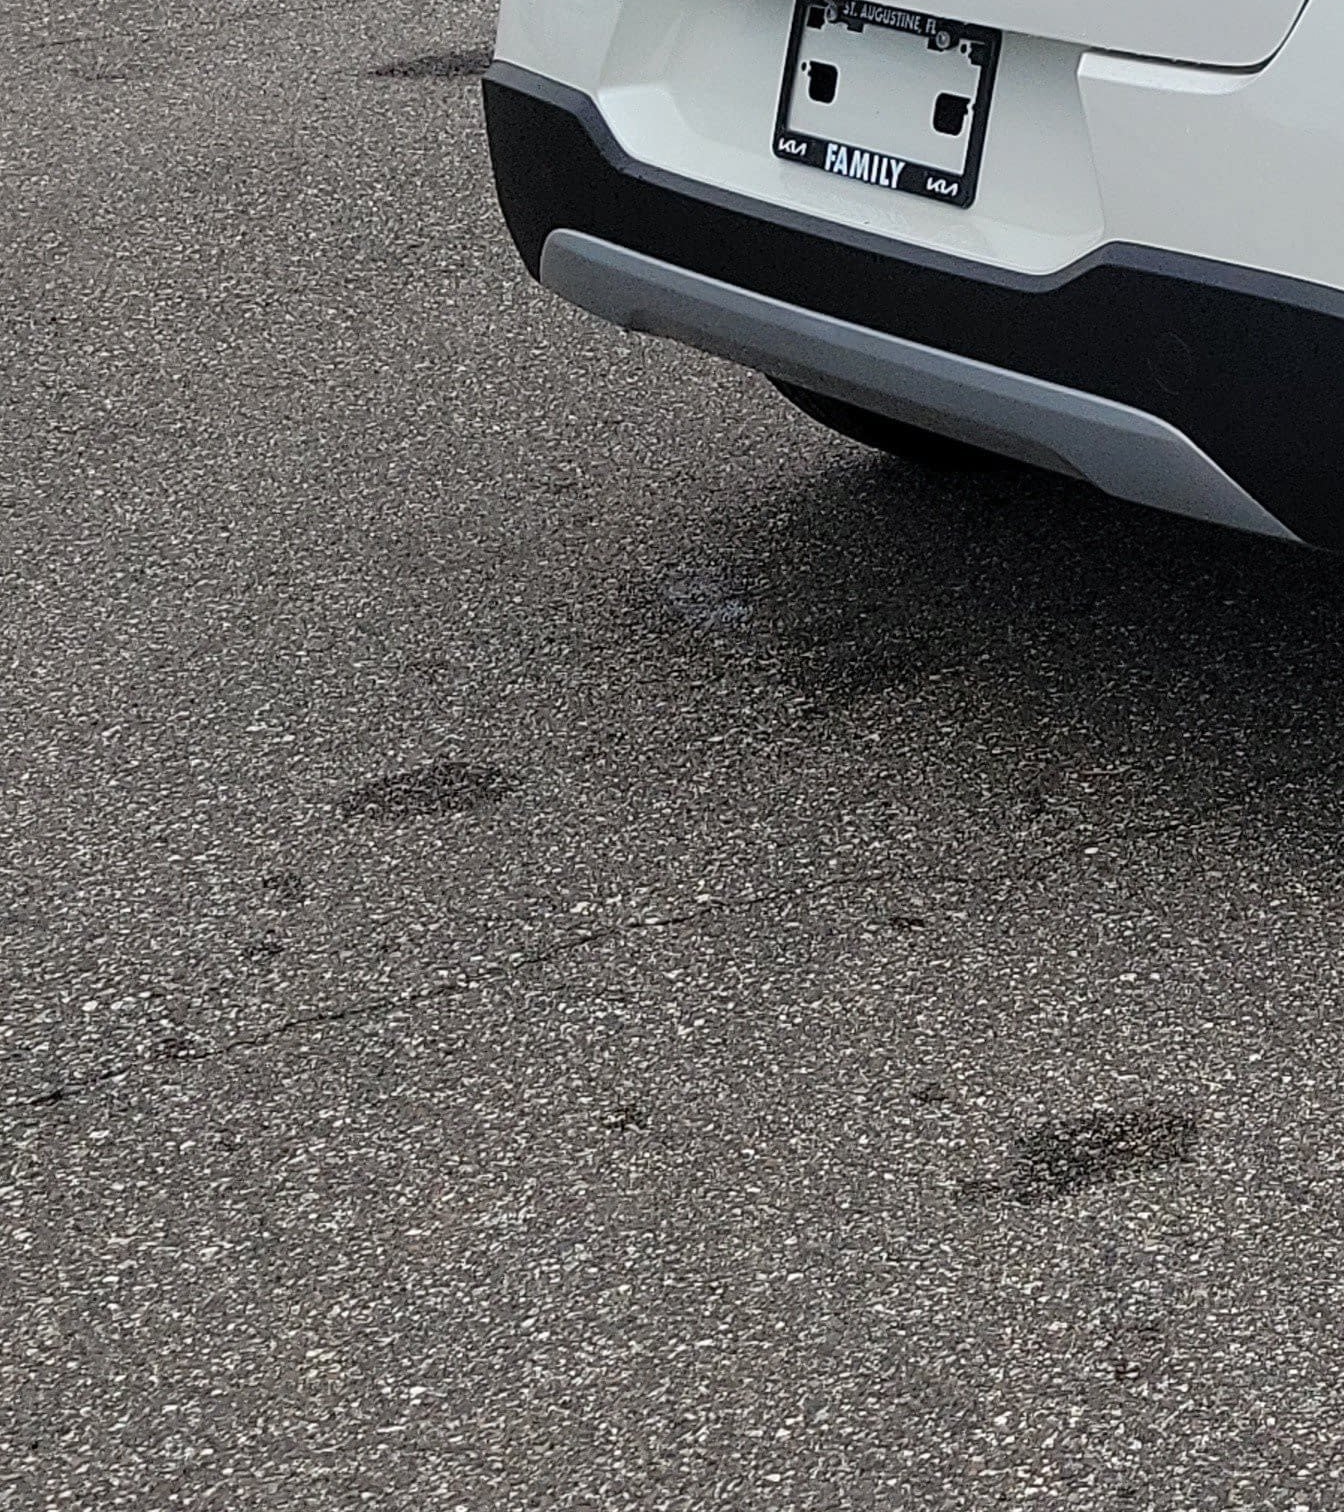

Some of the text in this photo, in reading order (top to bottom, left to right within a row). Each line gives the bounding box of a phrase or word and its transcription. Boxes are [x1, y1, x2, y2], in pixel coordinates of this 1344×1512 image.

[926, 20, 937, 35] FL
[779, 137, 807, 156] KIA
[824, 143, 906, 189] FAMILY
[926, 177, 959, 197] KIA
